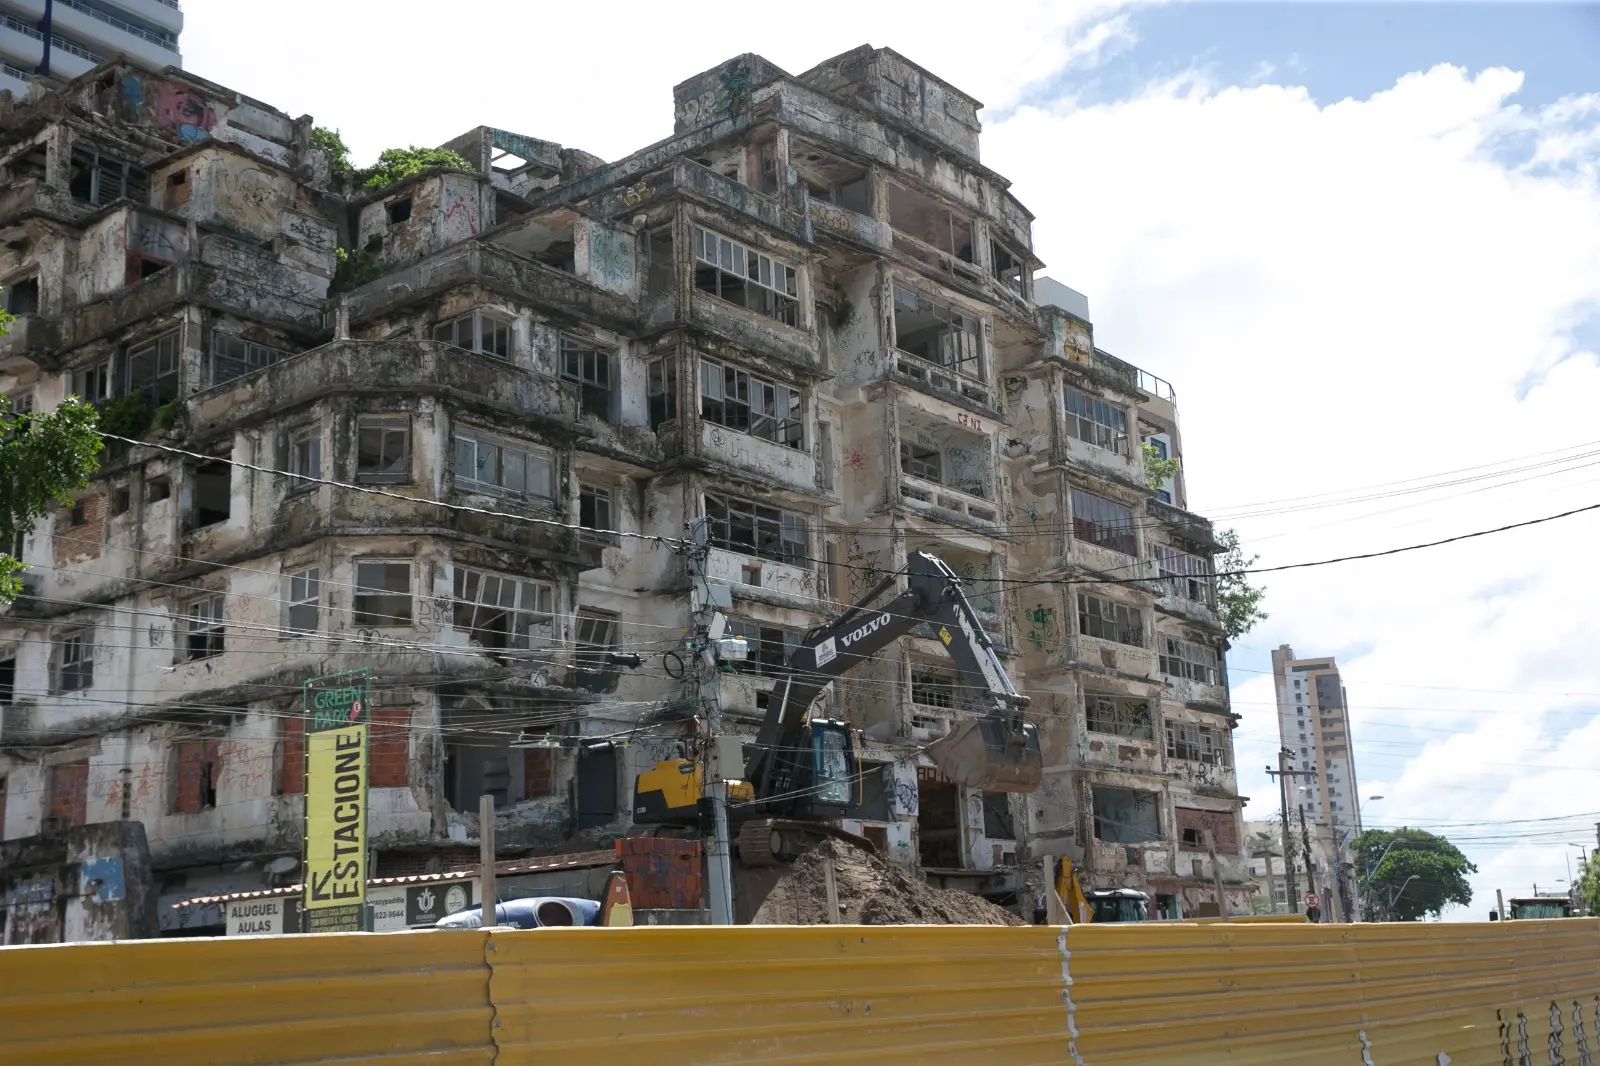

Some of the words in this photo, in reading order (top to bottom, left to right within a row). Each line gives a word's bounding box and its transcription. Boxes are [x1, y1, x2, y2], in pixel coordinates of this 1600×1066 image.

[841, 612, 891, 647] VOLVO
[314, 684, 361, 709] GREEN
[314, 708, 350, 729] PARK
[332, 731, 361, 900] ESTACIONE
[231, 904, 278, 918] ALUGUEL
[237, 920, 271, 934] AULAS
